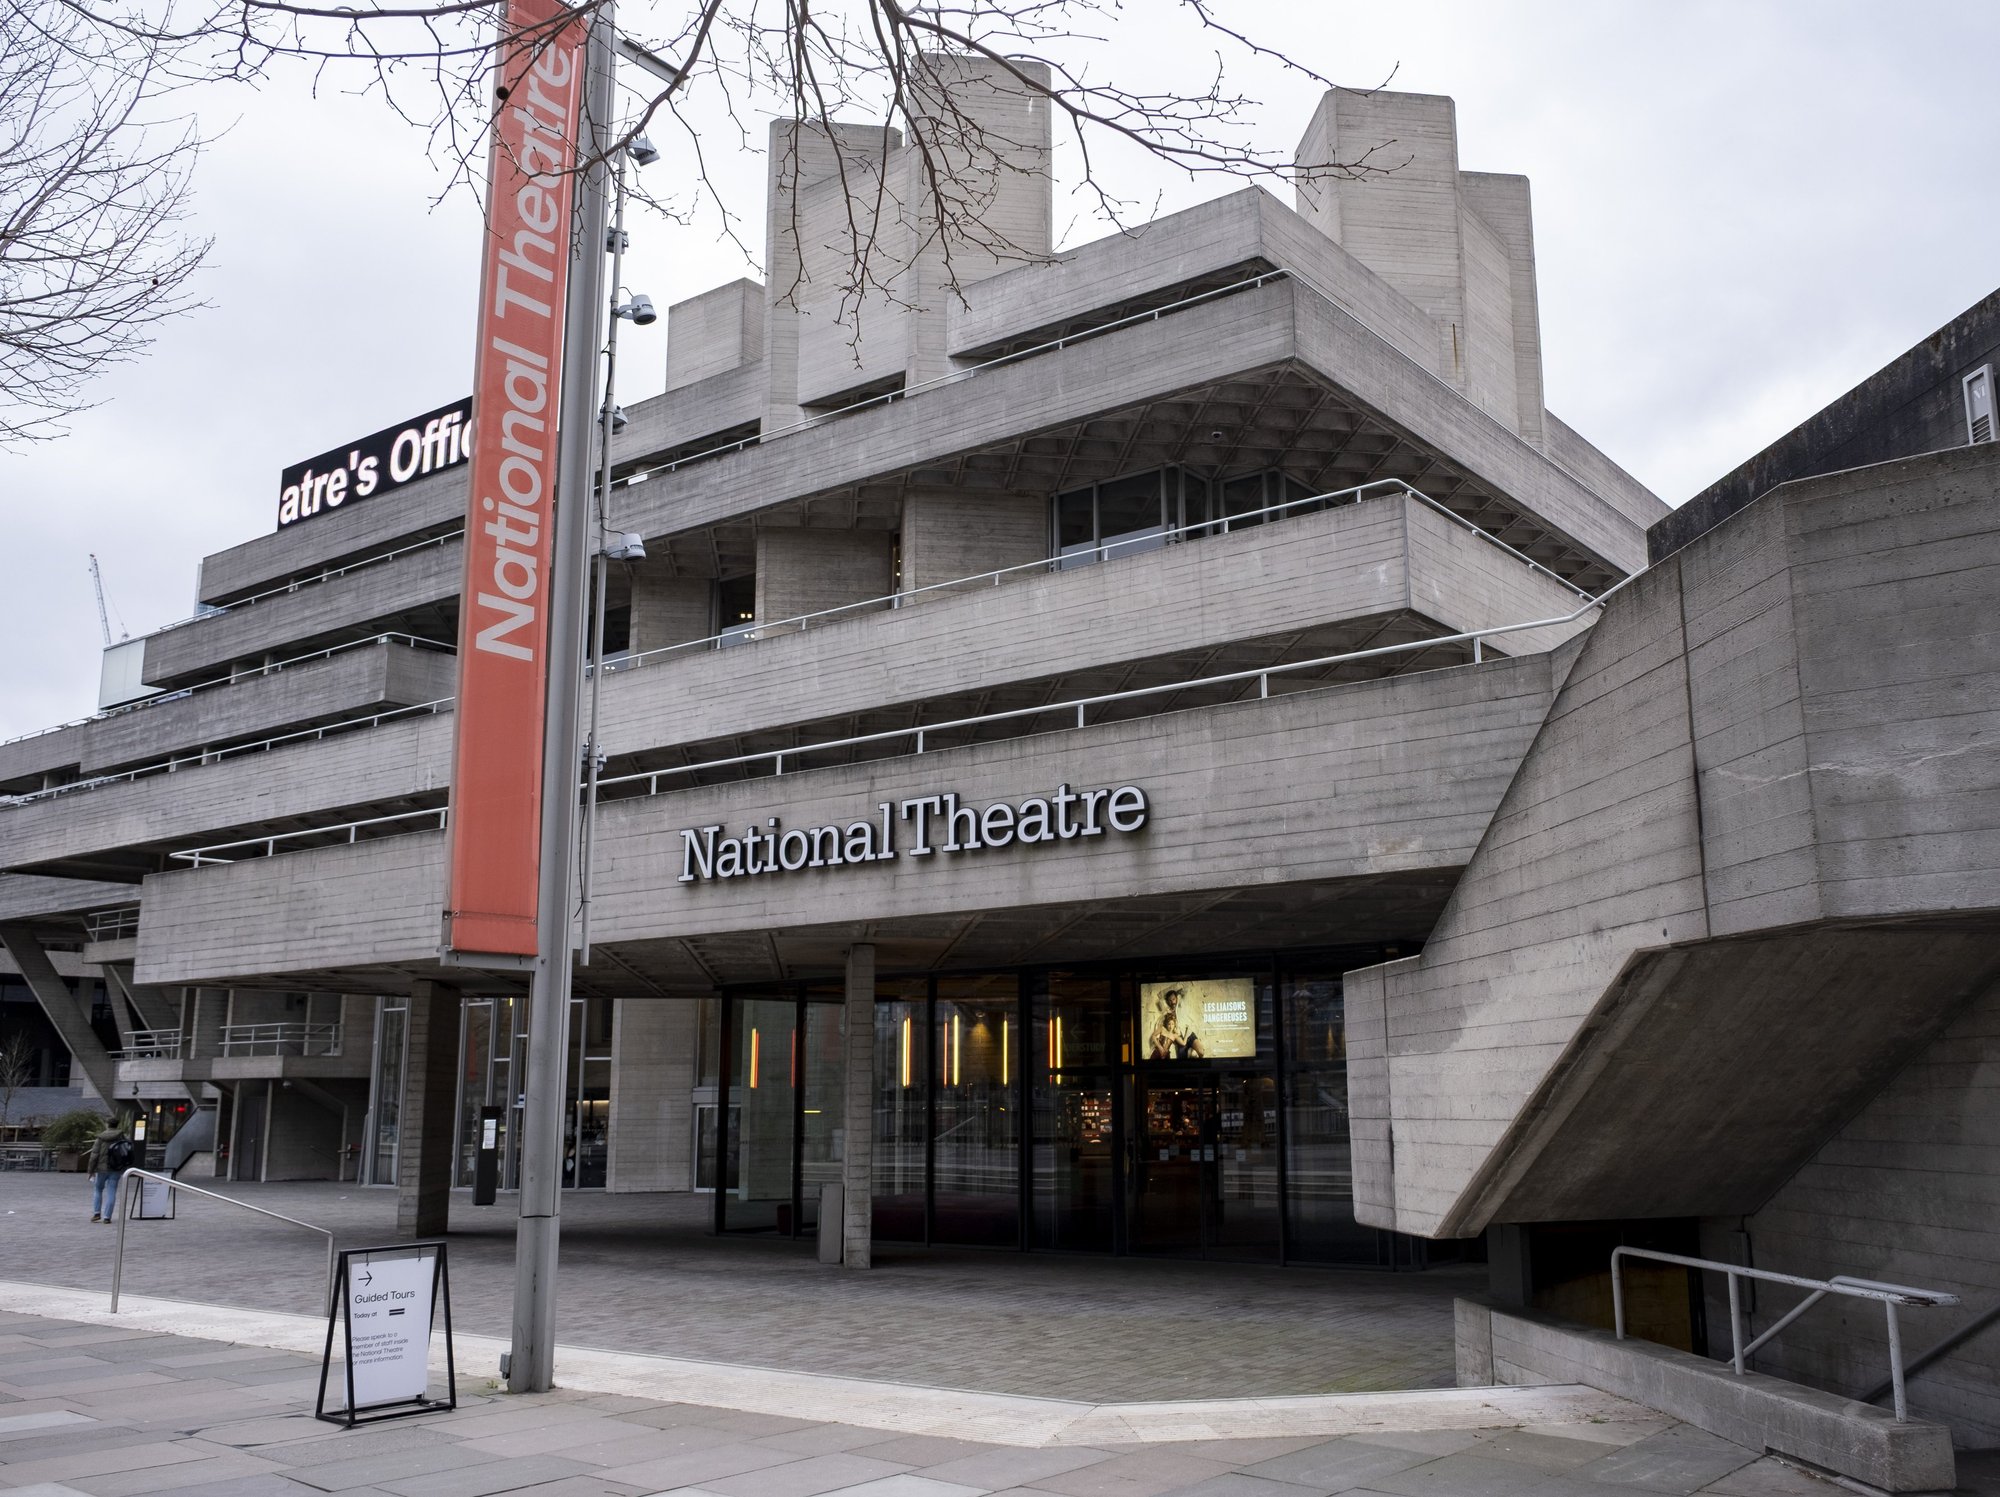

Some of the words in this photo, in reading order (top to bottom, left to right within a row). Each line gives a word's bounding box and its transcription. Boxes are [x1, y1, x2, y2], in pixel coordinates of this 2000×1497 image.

[495, 38, 571, 318] Theatre
[279, 450, 380, 525] atre's
[474, 337, 549, 663] National
[677, 801, 899, 884] National
[901, 783, 1150, 857] Theatre
[1203, 1012, 1248, 1023] DANGEREUSES
[1204, 1003, 1216, 1013] LES
[1216, 1001, 1246, 1012] LIAISONS
[354, 1292, 389, 1304] Guided
[390, 1290, 415, 1300] Tours
